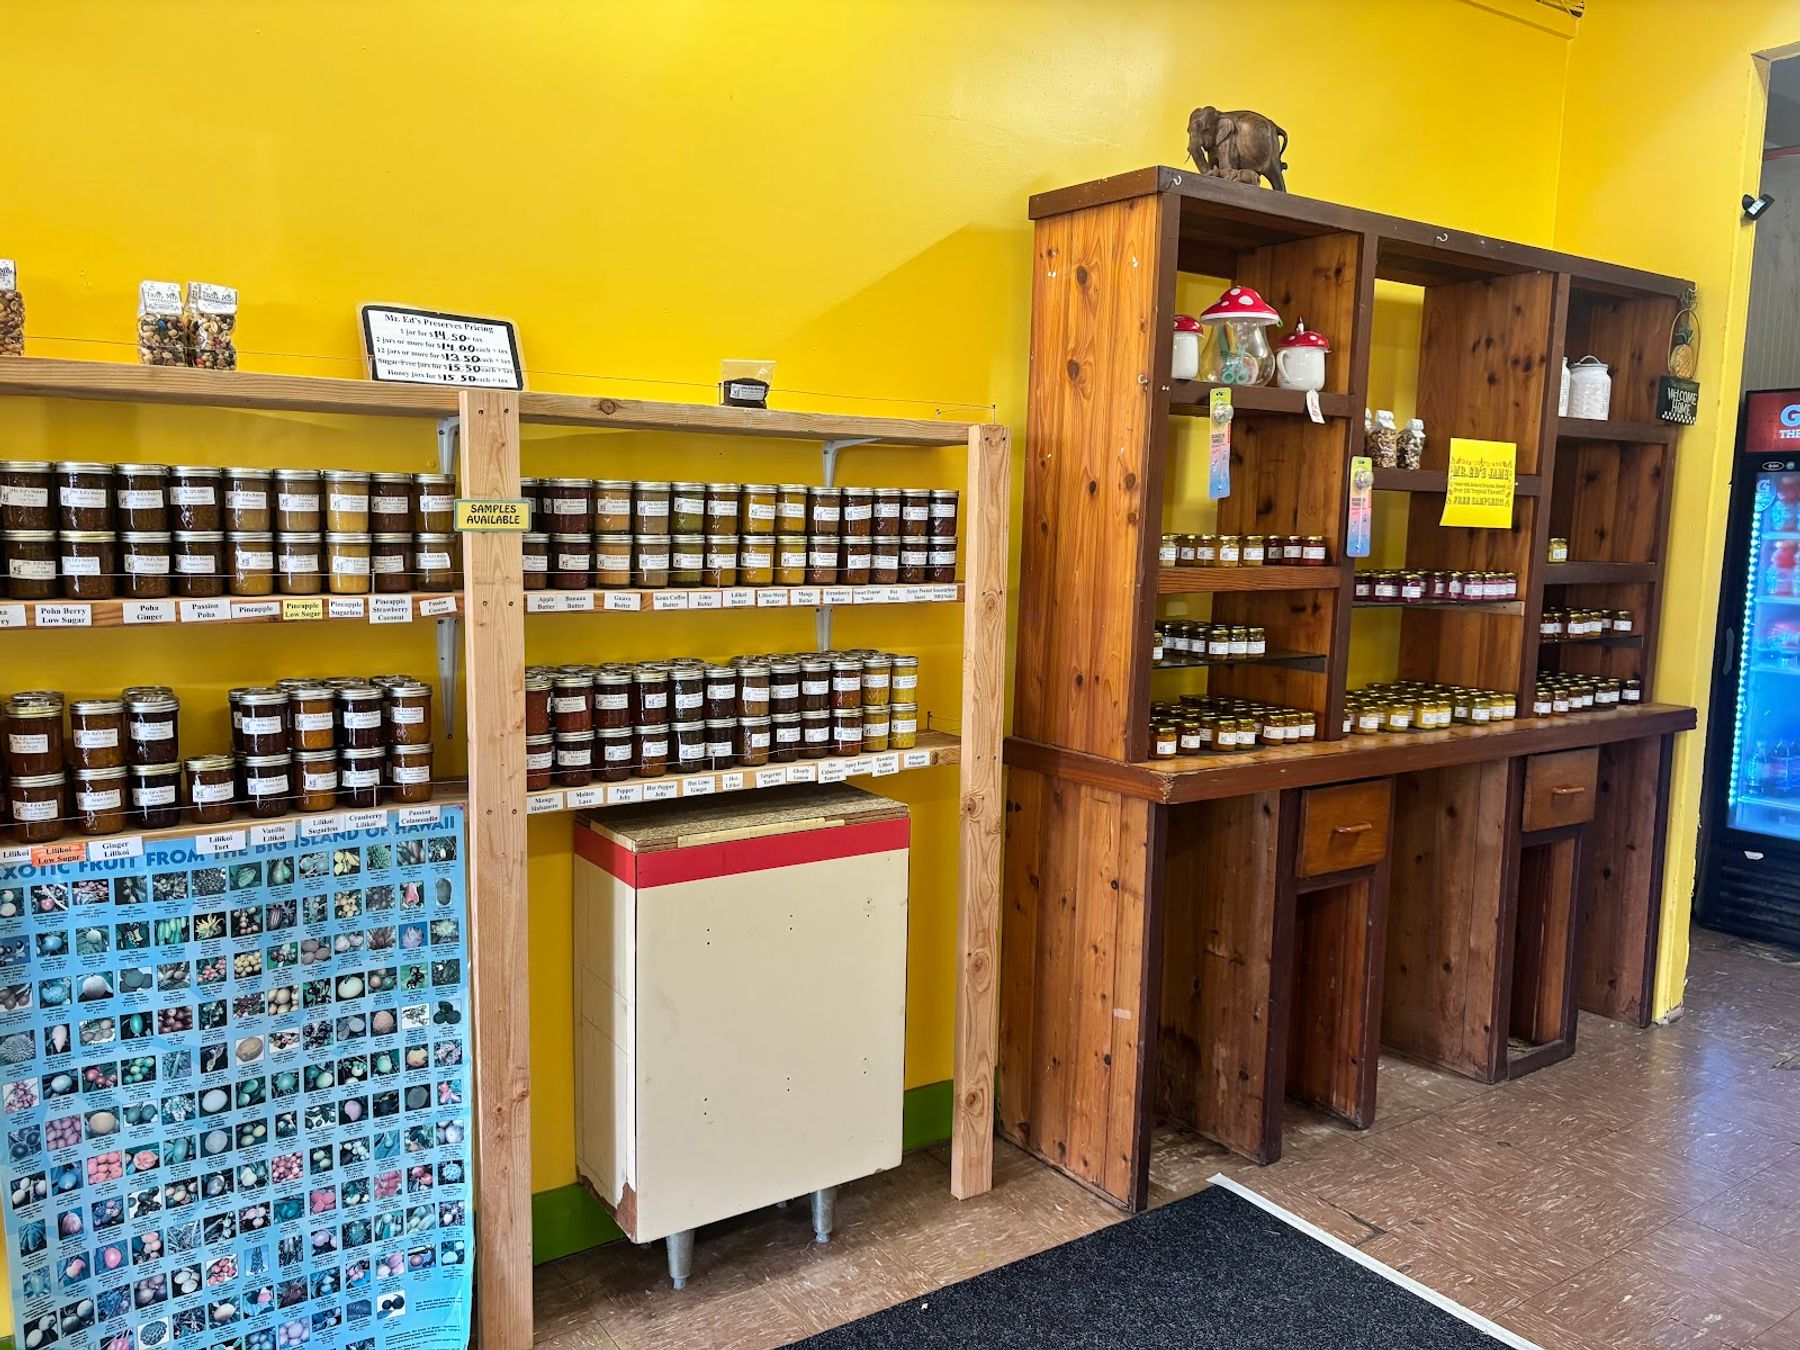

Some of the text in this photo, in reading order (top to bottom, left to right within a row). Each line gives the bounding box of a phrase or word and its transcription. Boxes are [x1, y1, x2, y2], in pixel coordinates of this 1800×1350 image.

[385, 314, 494, 334] Mr. Ed's Preserves Pricing
[383, 336, 396, 344] jars
[387, 347, 400, 355] jars
[1667, 387, 1698, 405] WELCOME
[1671, 400, 1692, 416] HOME
[471, 504, 517, 514] SAMPLES
[467, 515, 520, 525] AVAILABLE
[286, 602, 320, 610] Pineapple
[330, 601, 363, 609] Pineapple
[375, 598, 406, 606] Pineapple
[63, 608, 87, 616] Berry
[239, 606, 274, 614] Pineapple
[285, 610, 322, 618] Low Sugar
[330, 609, 363, 617] Sugarless
[372, 606, 409, 614] Strawberry
[61, 617, 86, 625] Sugar
[136, 613, 163, 622] Ginger
[531, 803, 558, 812] Habanero
[408, 809, 432, 817] Passion
[349, 813, 383, 822] Cranberry
[313, 818, 335, 826] Lilikoi
[308, 827, 339, 835] Sugarless
[209, 835, 233, 843] Lilikoi
[102, 841, 130, 850] Ginger
[146, 849, 205, 867] FROM
[294, 829, 361, 848] ISLAND
[3, 850, 30, 859] Lilikoi
[46, 847, 72, 855] Lilikoi
[38, 854, 81, 865] Low Sugar
